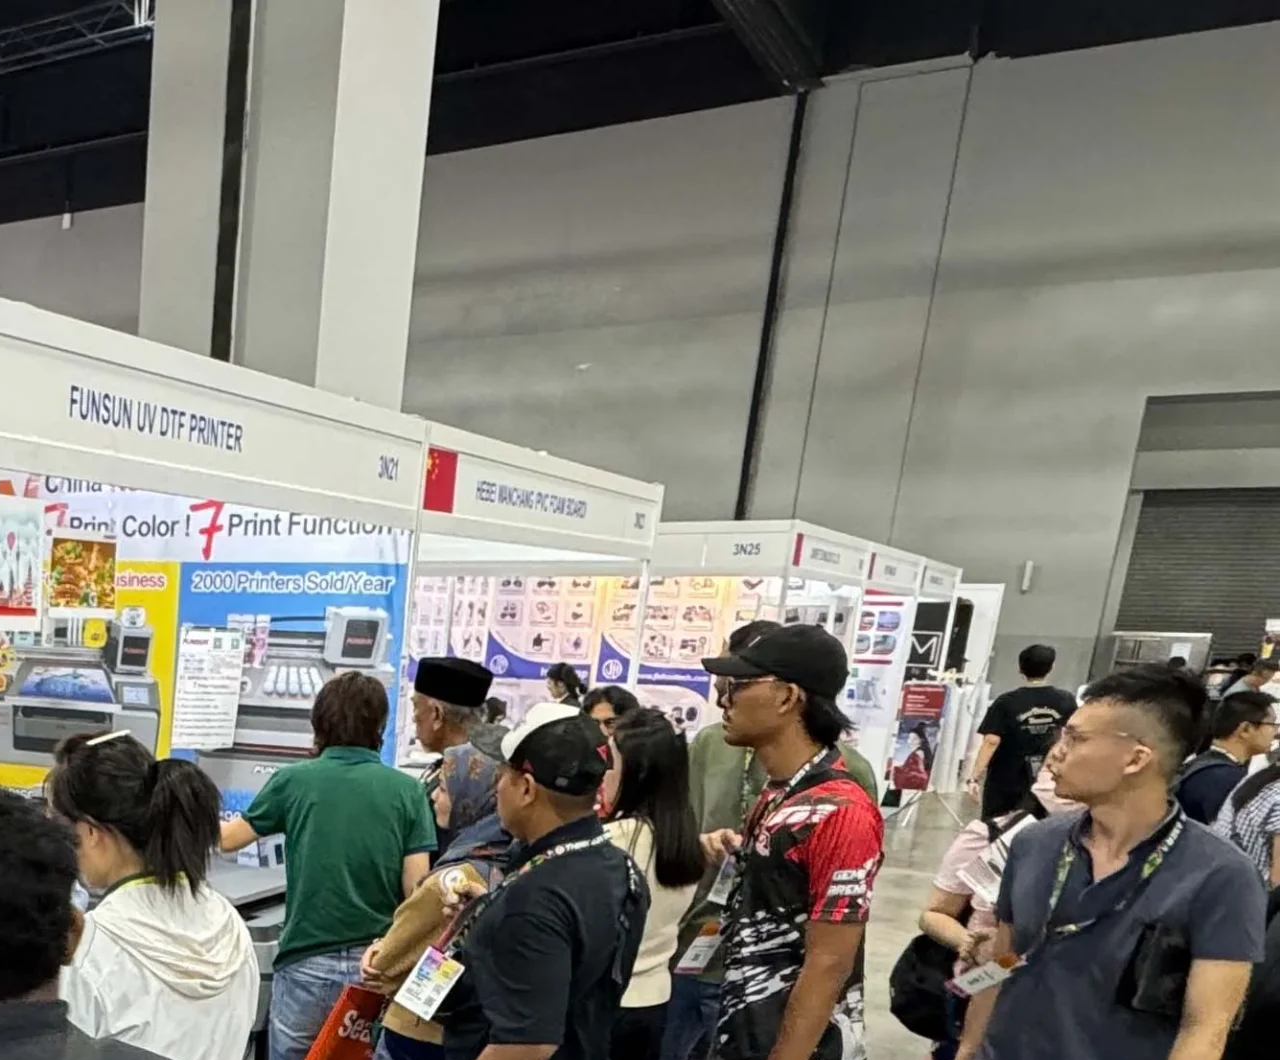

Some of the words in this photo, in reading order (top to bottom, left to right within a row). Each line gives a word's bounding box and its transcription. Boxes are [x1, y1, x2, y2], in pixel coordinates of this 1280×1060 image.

[70, 385, 133, 430] FUNSUN
[137, 402, 157, 434] UV
[160, 407, 186, 440] DTF
[189, 414, 243, 453] PRINTER
[378, 455, 399, 481] 3N21
[122, 514, 180, 538] Color
[190, 499, 224, 561] 7
[228, 513, 281, 537] Print
[732, 543, 761, 557] 3N25
[116, 572, 165, 588] siness
[192, 573, 233, 592] 2000
[237, 574, 301, 592] Printers
[306, 574, 392, 594] Sold/Year
